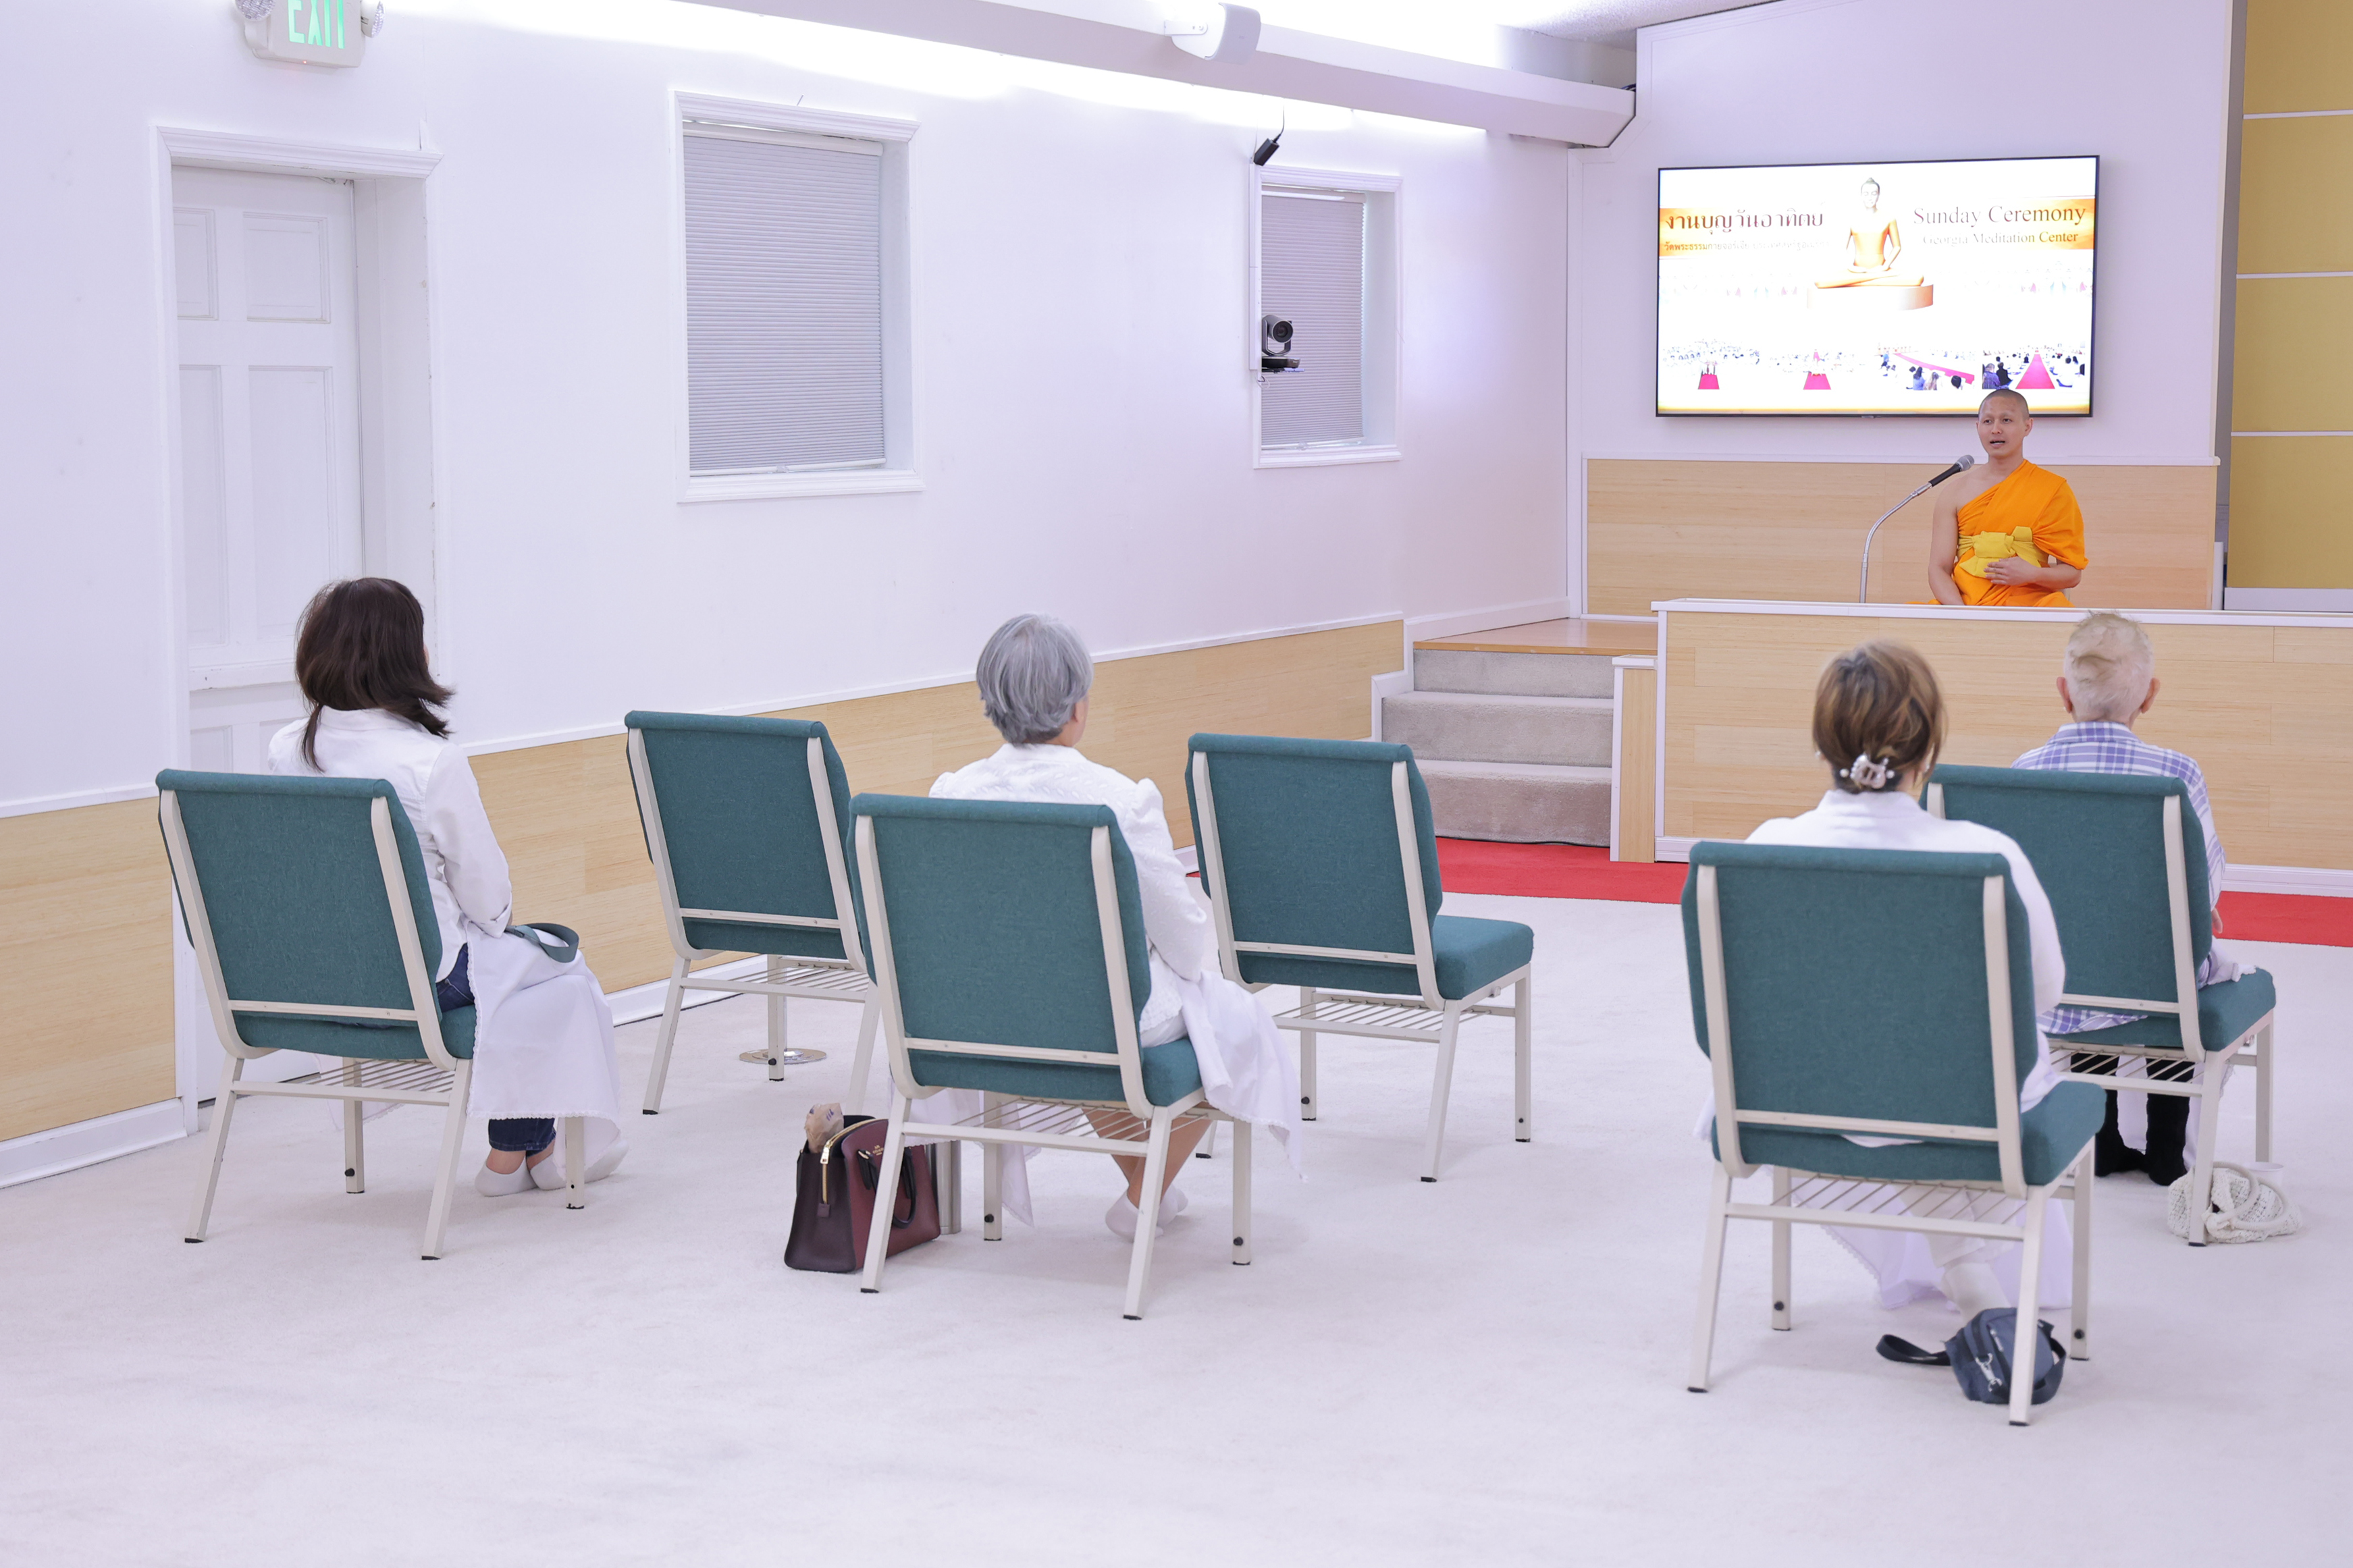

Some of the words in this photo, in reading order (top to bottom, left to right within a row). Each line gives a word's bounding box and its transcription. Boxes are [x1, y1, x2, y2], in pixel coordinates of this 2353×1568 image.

[1913, 206, 1981, 227] Sunday
[1988, 205, 2086, 225] Ceremony
[1923, 234, 1967, 246] Georgia
[1973, 232, 2035, 244] Meditation
[2039, 232, 2078, 242] Center
